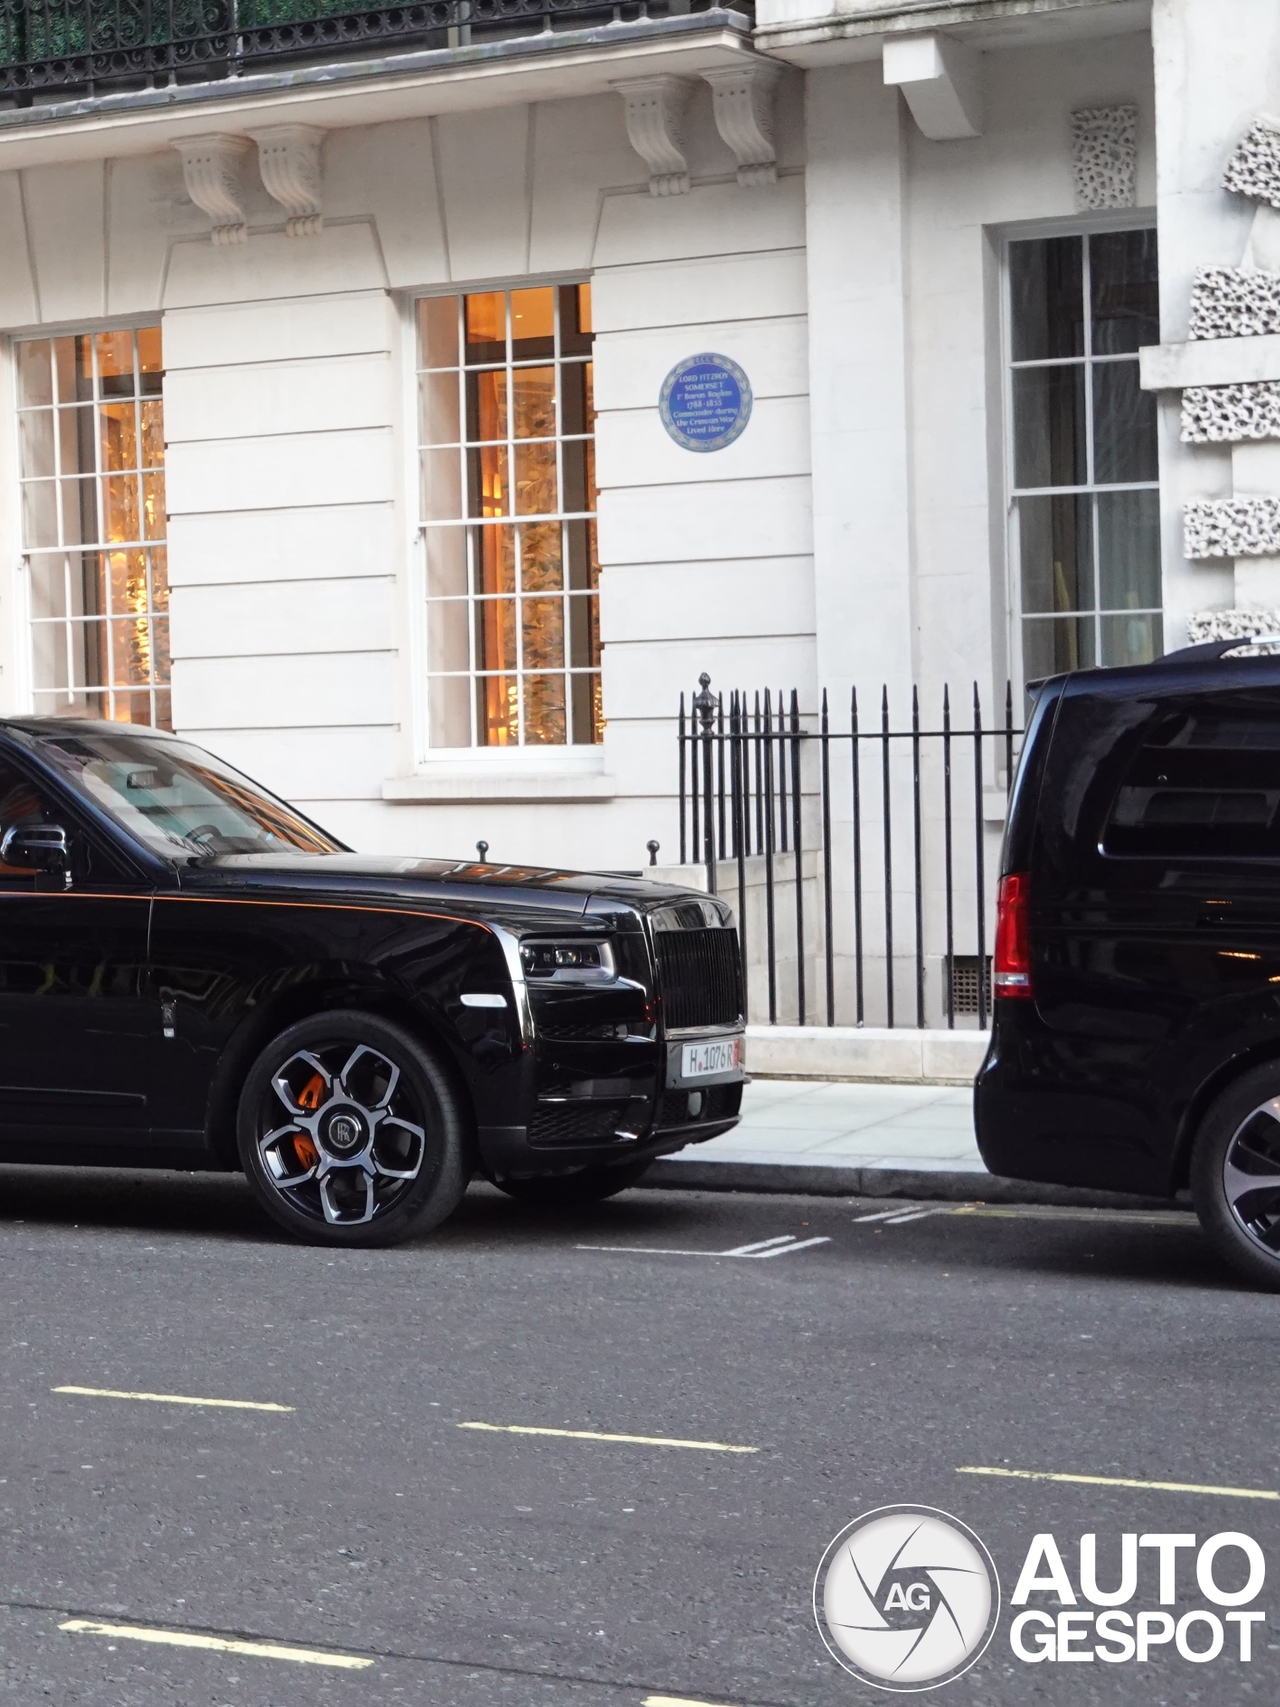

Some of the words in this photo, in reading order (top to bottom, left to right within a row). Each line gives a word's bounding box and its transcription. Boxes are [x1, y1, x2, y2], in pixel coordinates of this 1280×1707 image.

[679, 374, 697, 382] LORD
[699, 372, 728, 380] FITZROY
[685, 382, 723, 391] SOMERSET
[673, 409, 713, 417] Commander
[715, 407, 738, 415] during
[689, 417, 718, 426] Crimean
[687, 426, 705, 434] Lived
